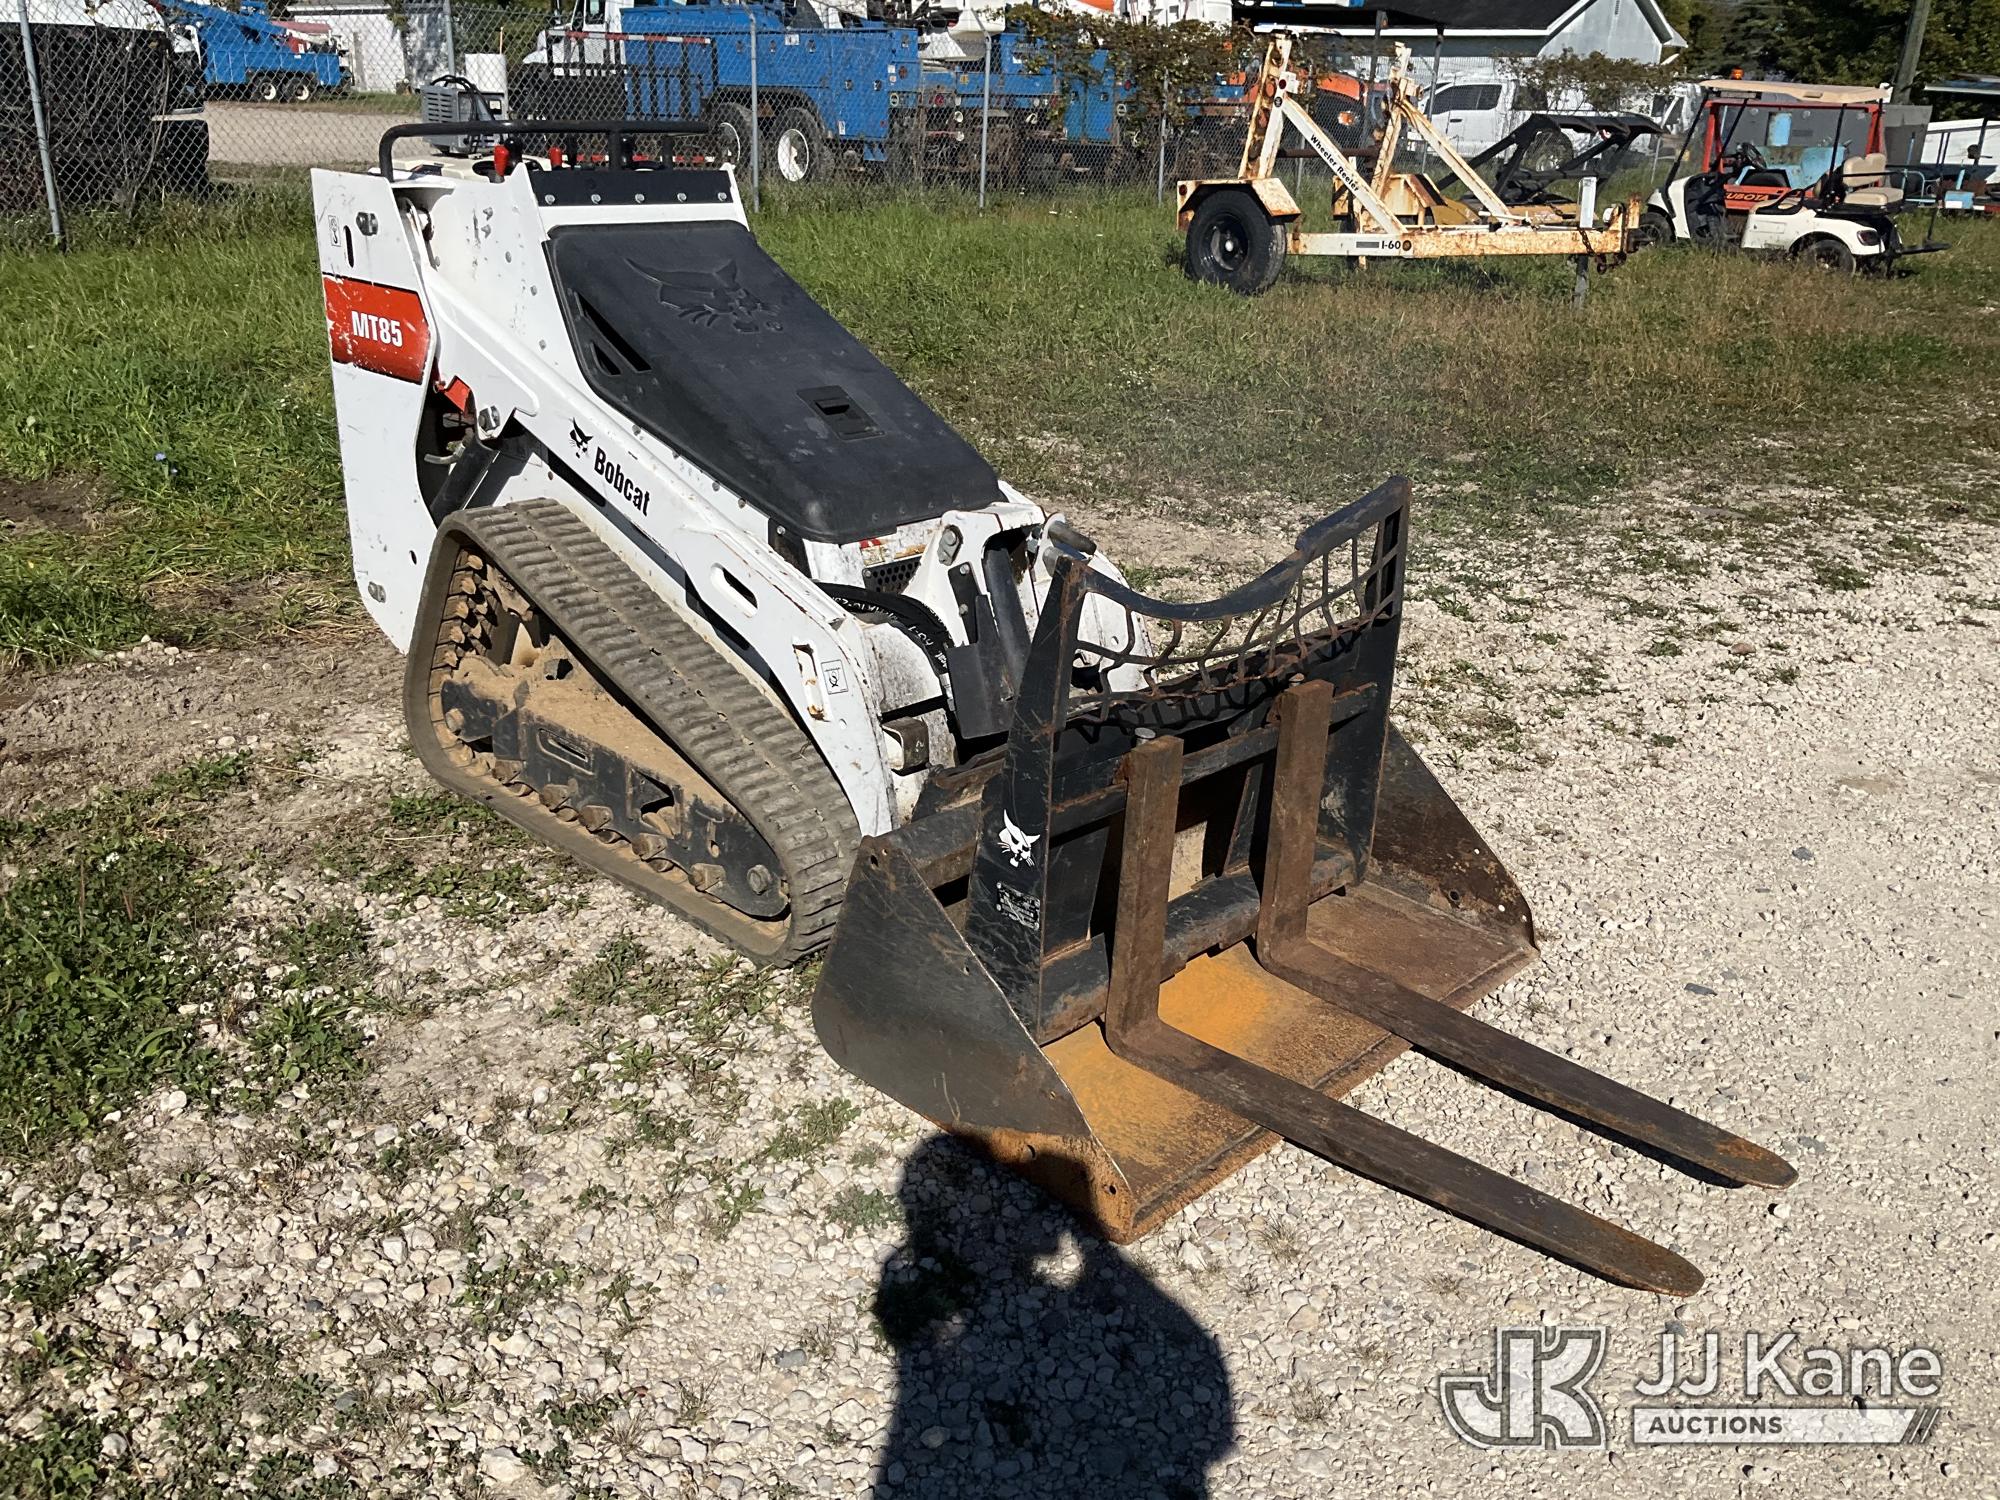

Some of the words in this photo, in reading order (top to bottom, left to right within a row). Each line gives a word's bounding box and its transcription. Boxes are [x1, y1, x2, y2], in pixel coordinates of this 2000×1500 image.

[1310, 134, 1337, 167] Wheeler
[1337, 166, 1359, 192] Reeler
[1726, 193, 1769, 201] UBOTA
[351, 310, 403, 348] MT85
[594, 446, 651, 517] Bobcat
